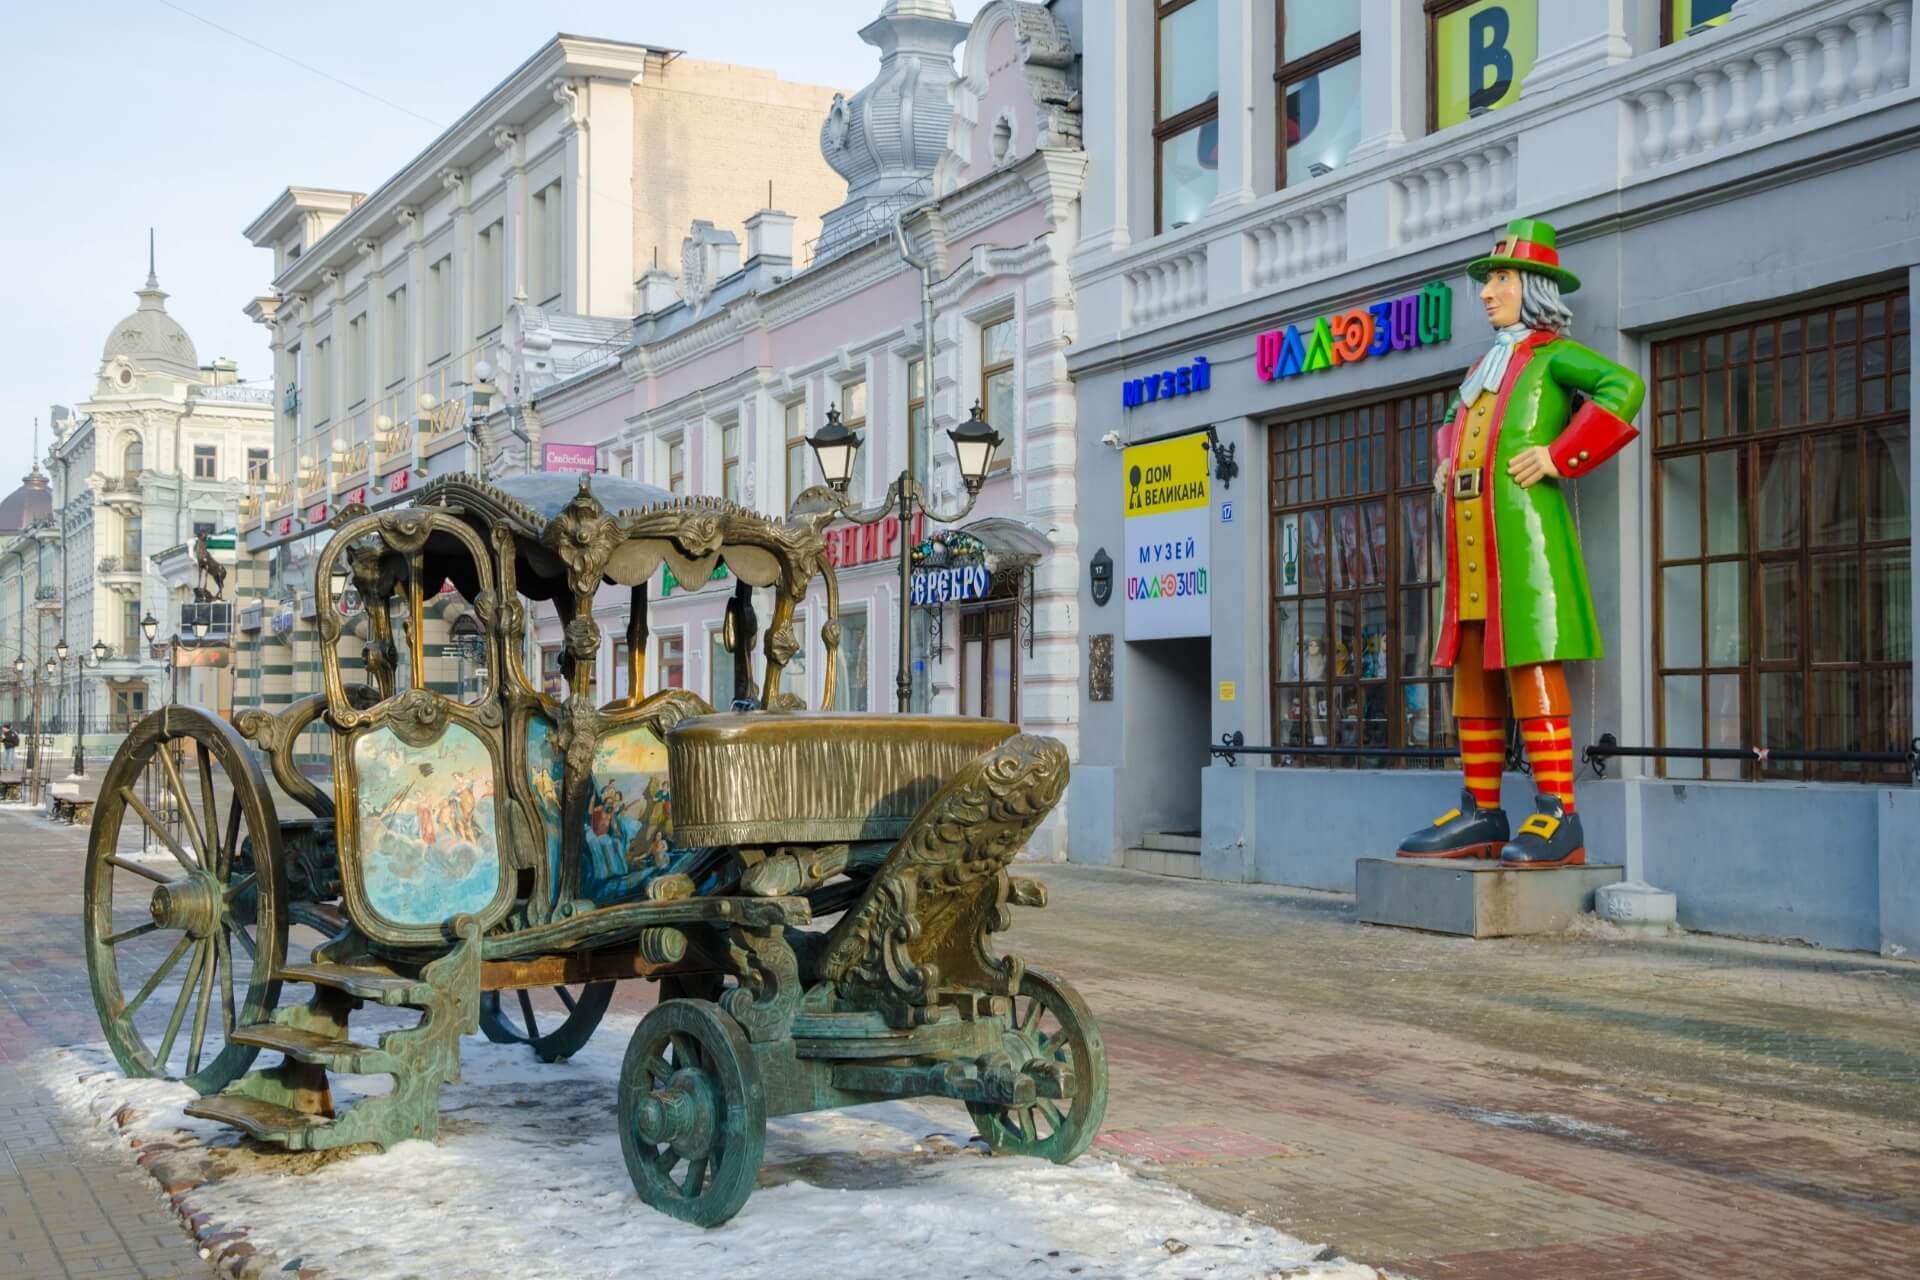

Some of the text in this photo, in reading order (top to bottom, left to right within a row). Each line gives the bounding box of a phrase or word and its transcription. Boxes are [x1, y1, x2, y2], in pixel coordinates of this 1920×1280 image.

[1123, 280, 1452, 408] МУЗЕЙ ИЛЛЮЗИЙ
[1145, 464, 1172, 485] ДОМ
[1145, 481, 1205, 506] ВЕЛИКАНА
[1139, 537, 1195, 563] МУЗЕЙ
[1095, 565, 1104, 575] 17
[911, 564, 986, 606] ЕРЕБРО
[1127, 567, 1207, 600] ИЛЛЮЗИЙ
